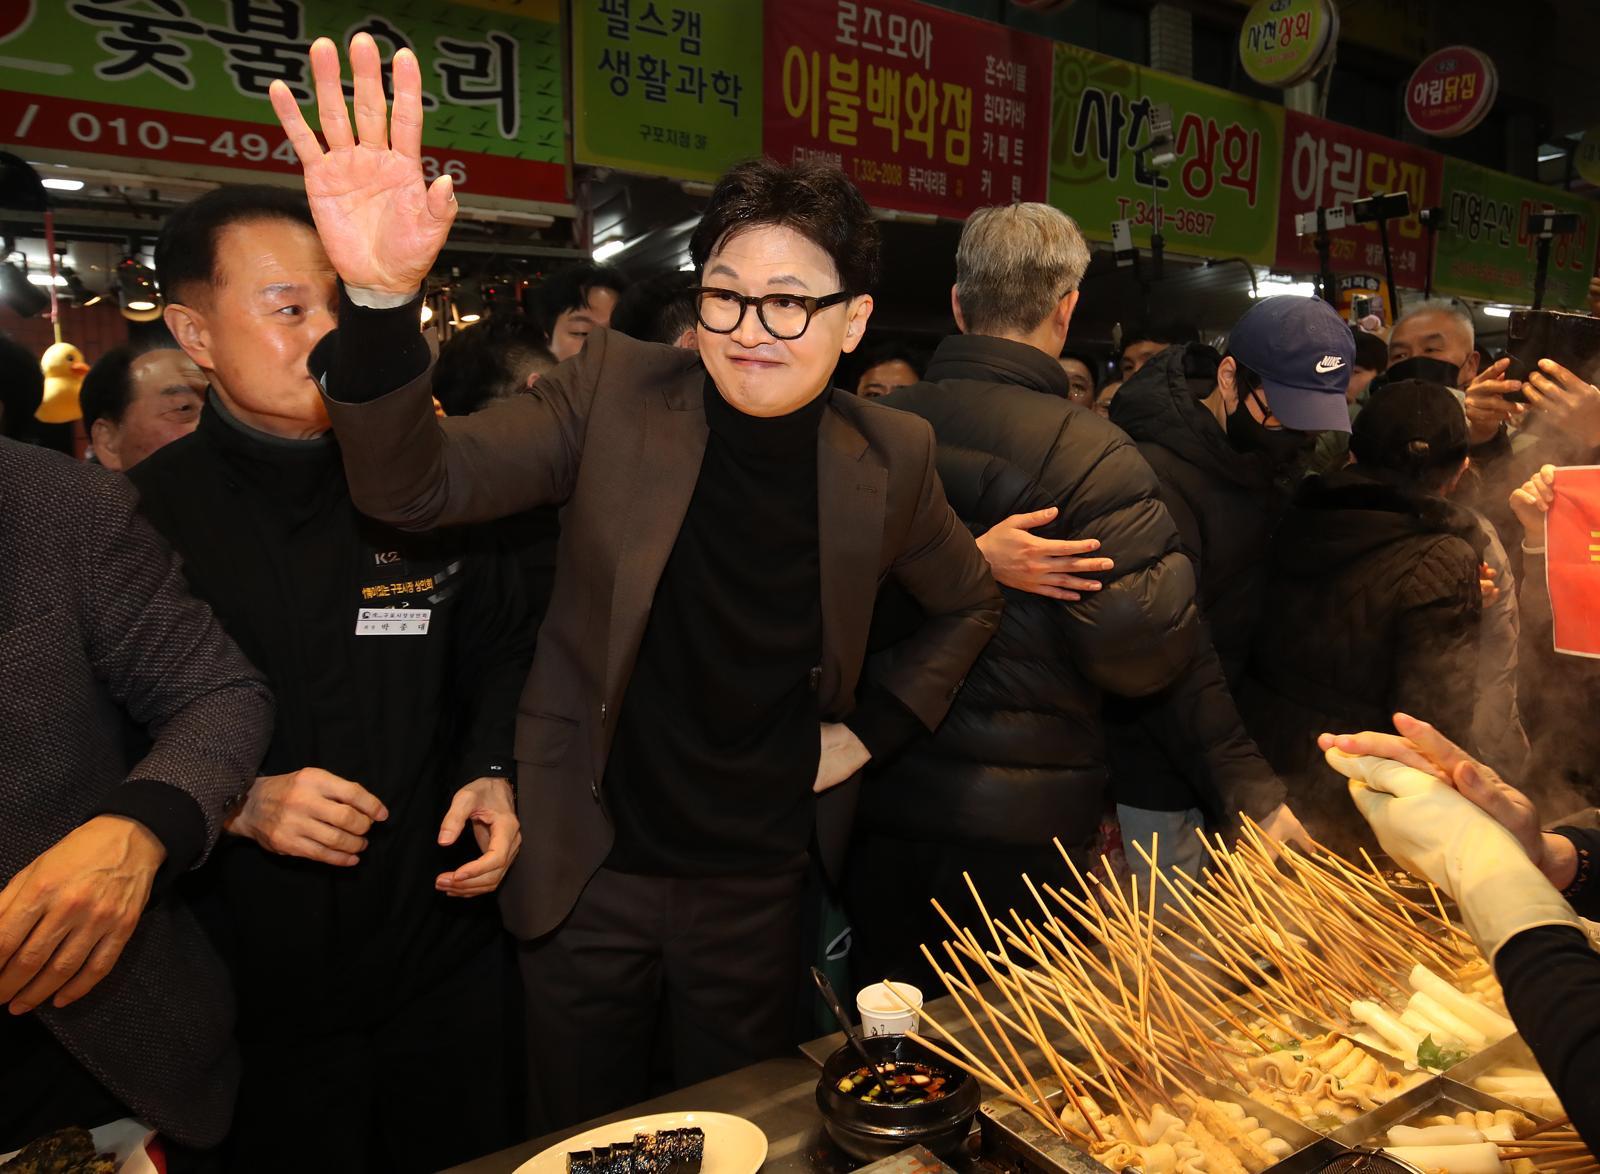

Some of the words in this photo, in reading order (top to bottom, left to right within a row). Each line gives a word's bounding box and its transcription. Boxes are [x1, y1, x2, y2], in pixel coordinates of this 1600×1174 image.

[836, 1, 933, 69] 로즈모아
[596, 47, 743, 117] 생활과학
[783, 45, 972, 165] 이불백화점
[638, 123, 690, 149] 구포지점
[1321, 354, 1344, 367] NIKE
[375, 550, 401, 565] K2
